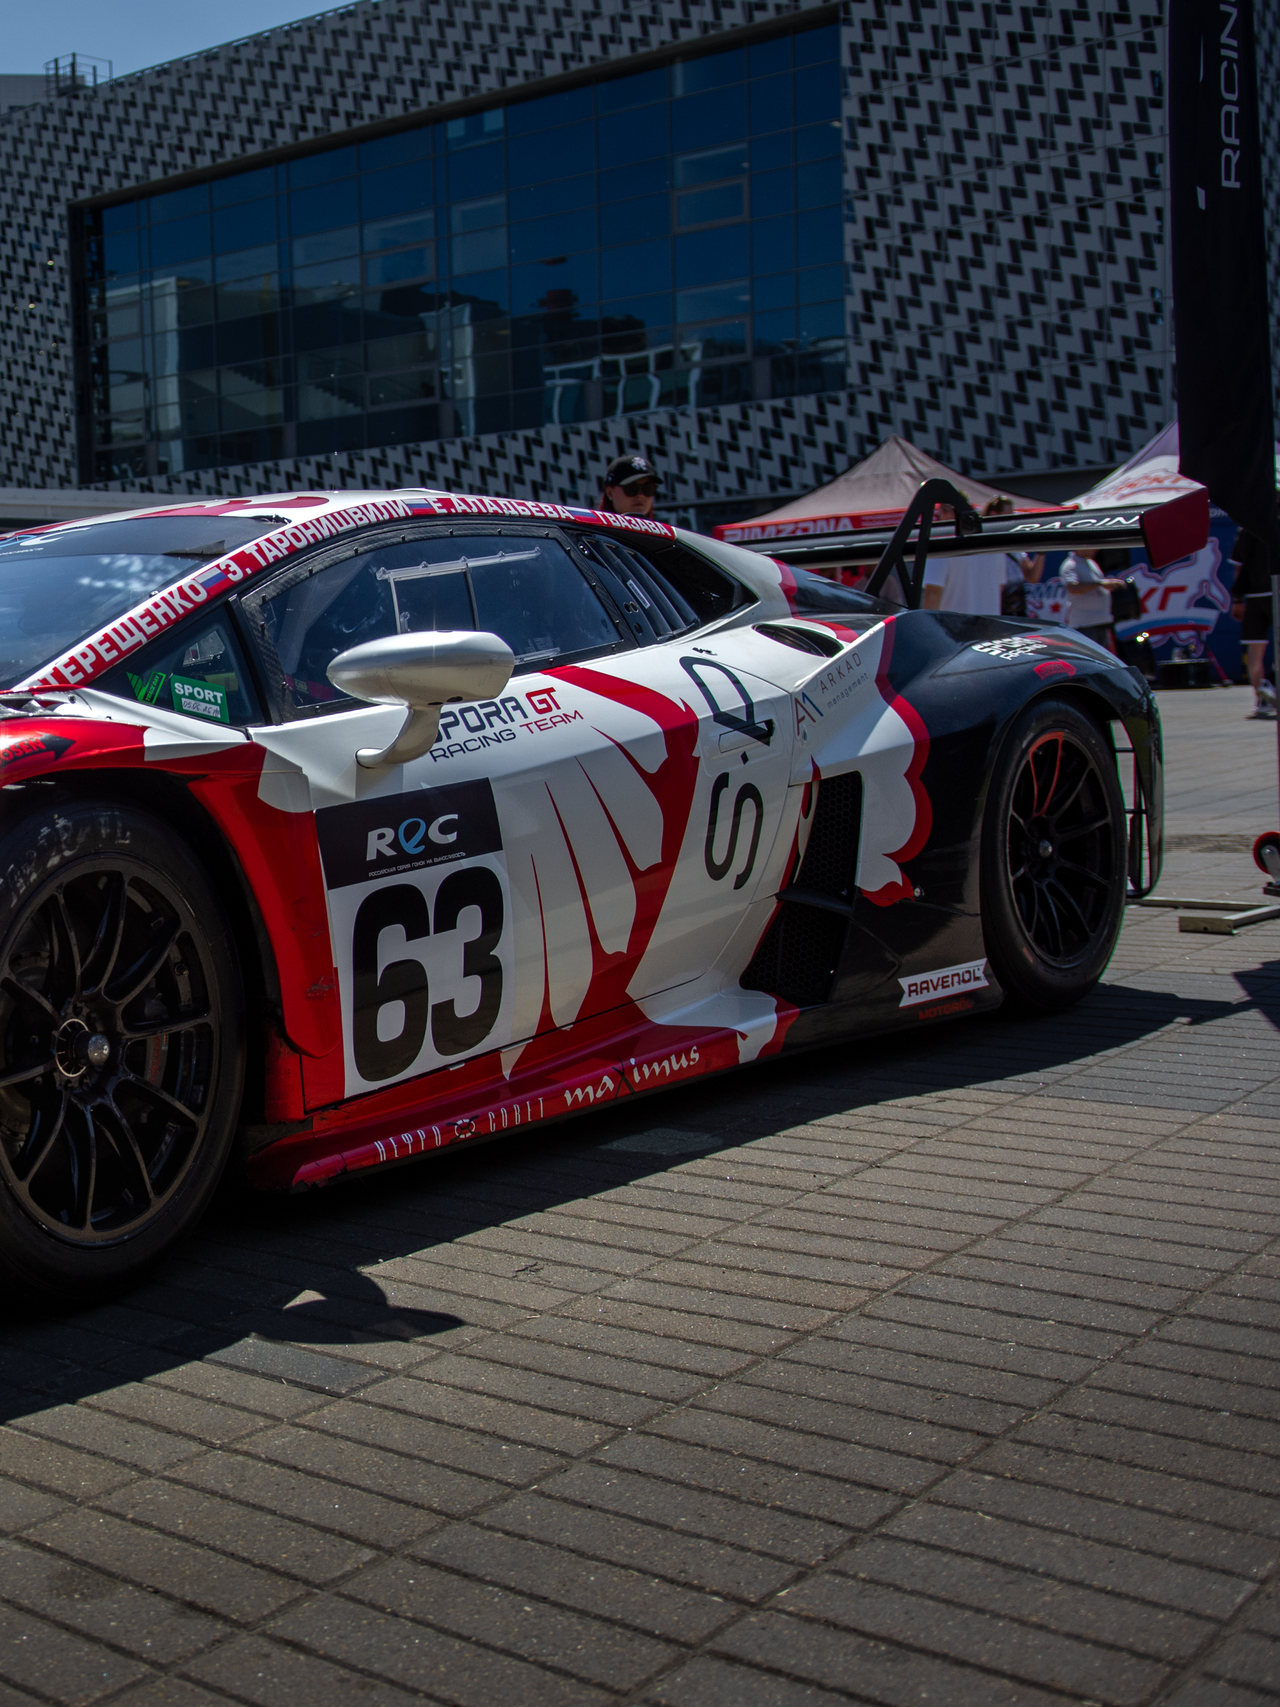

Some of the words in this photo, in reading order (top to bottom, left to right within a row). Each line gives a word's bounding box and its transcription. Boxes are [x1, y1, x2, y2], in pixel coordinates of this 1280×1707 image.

[241, 499, 413, 567] ТАРОНИШВИЛИ
[593, 511, 672, 537] ГВАЗАВА
[1008, 516, 1140, 532] RACIN
[821, 652, 862, 693] ARKAD
[826, 672, 869, 709] management
[173, 682, 223, 704] SPORT
[435, 696, 528, 743] PORA
[526, 687, 561, 714] GT
[429, 728, 516, 762] RACING
[519, 710, 584, 734] TEAM
[368, 867, 396, 877] РОССИЙСКАЯ
[397, 863, 411, 871] СЕРИЯ
[412, 860, 426, 868] ГОНОК
[353, 866, 504, 1082] 63
[908, 968, 981, 997] RAVENOL
[374, 1125, 441, 1162] НЕФРО
[488, 1097, 545, 1133] СОВЕТ
